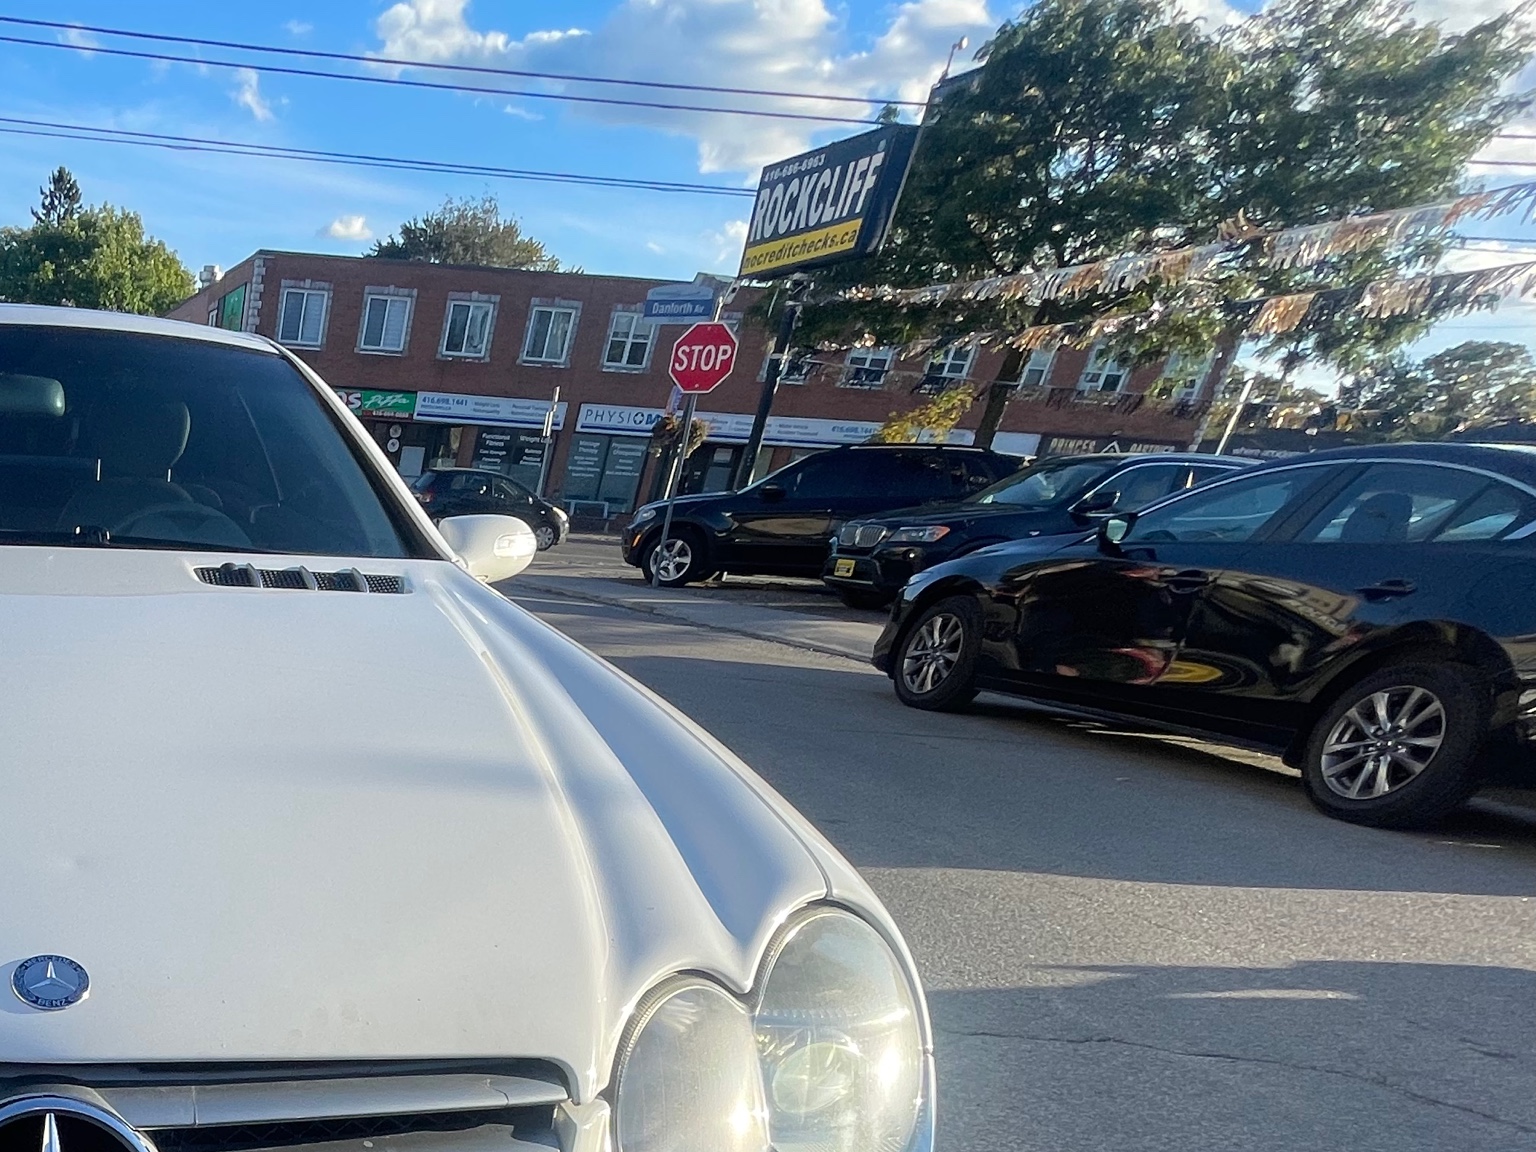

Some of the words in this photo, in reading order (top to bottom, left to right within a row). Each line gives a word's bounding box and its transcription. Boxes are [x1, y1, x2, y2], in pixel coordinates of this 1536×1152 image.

[750, 151, 885, 242] ROCKCLIFF
[743, 228, 858, 269] nocreditchecks.ca
[652, 301, 693, 314] Danforth
[674, 345, 732, 371] STOP
[37, 998, 69, 1007] BENZ
